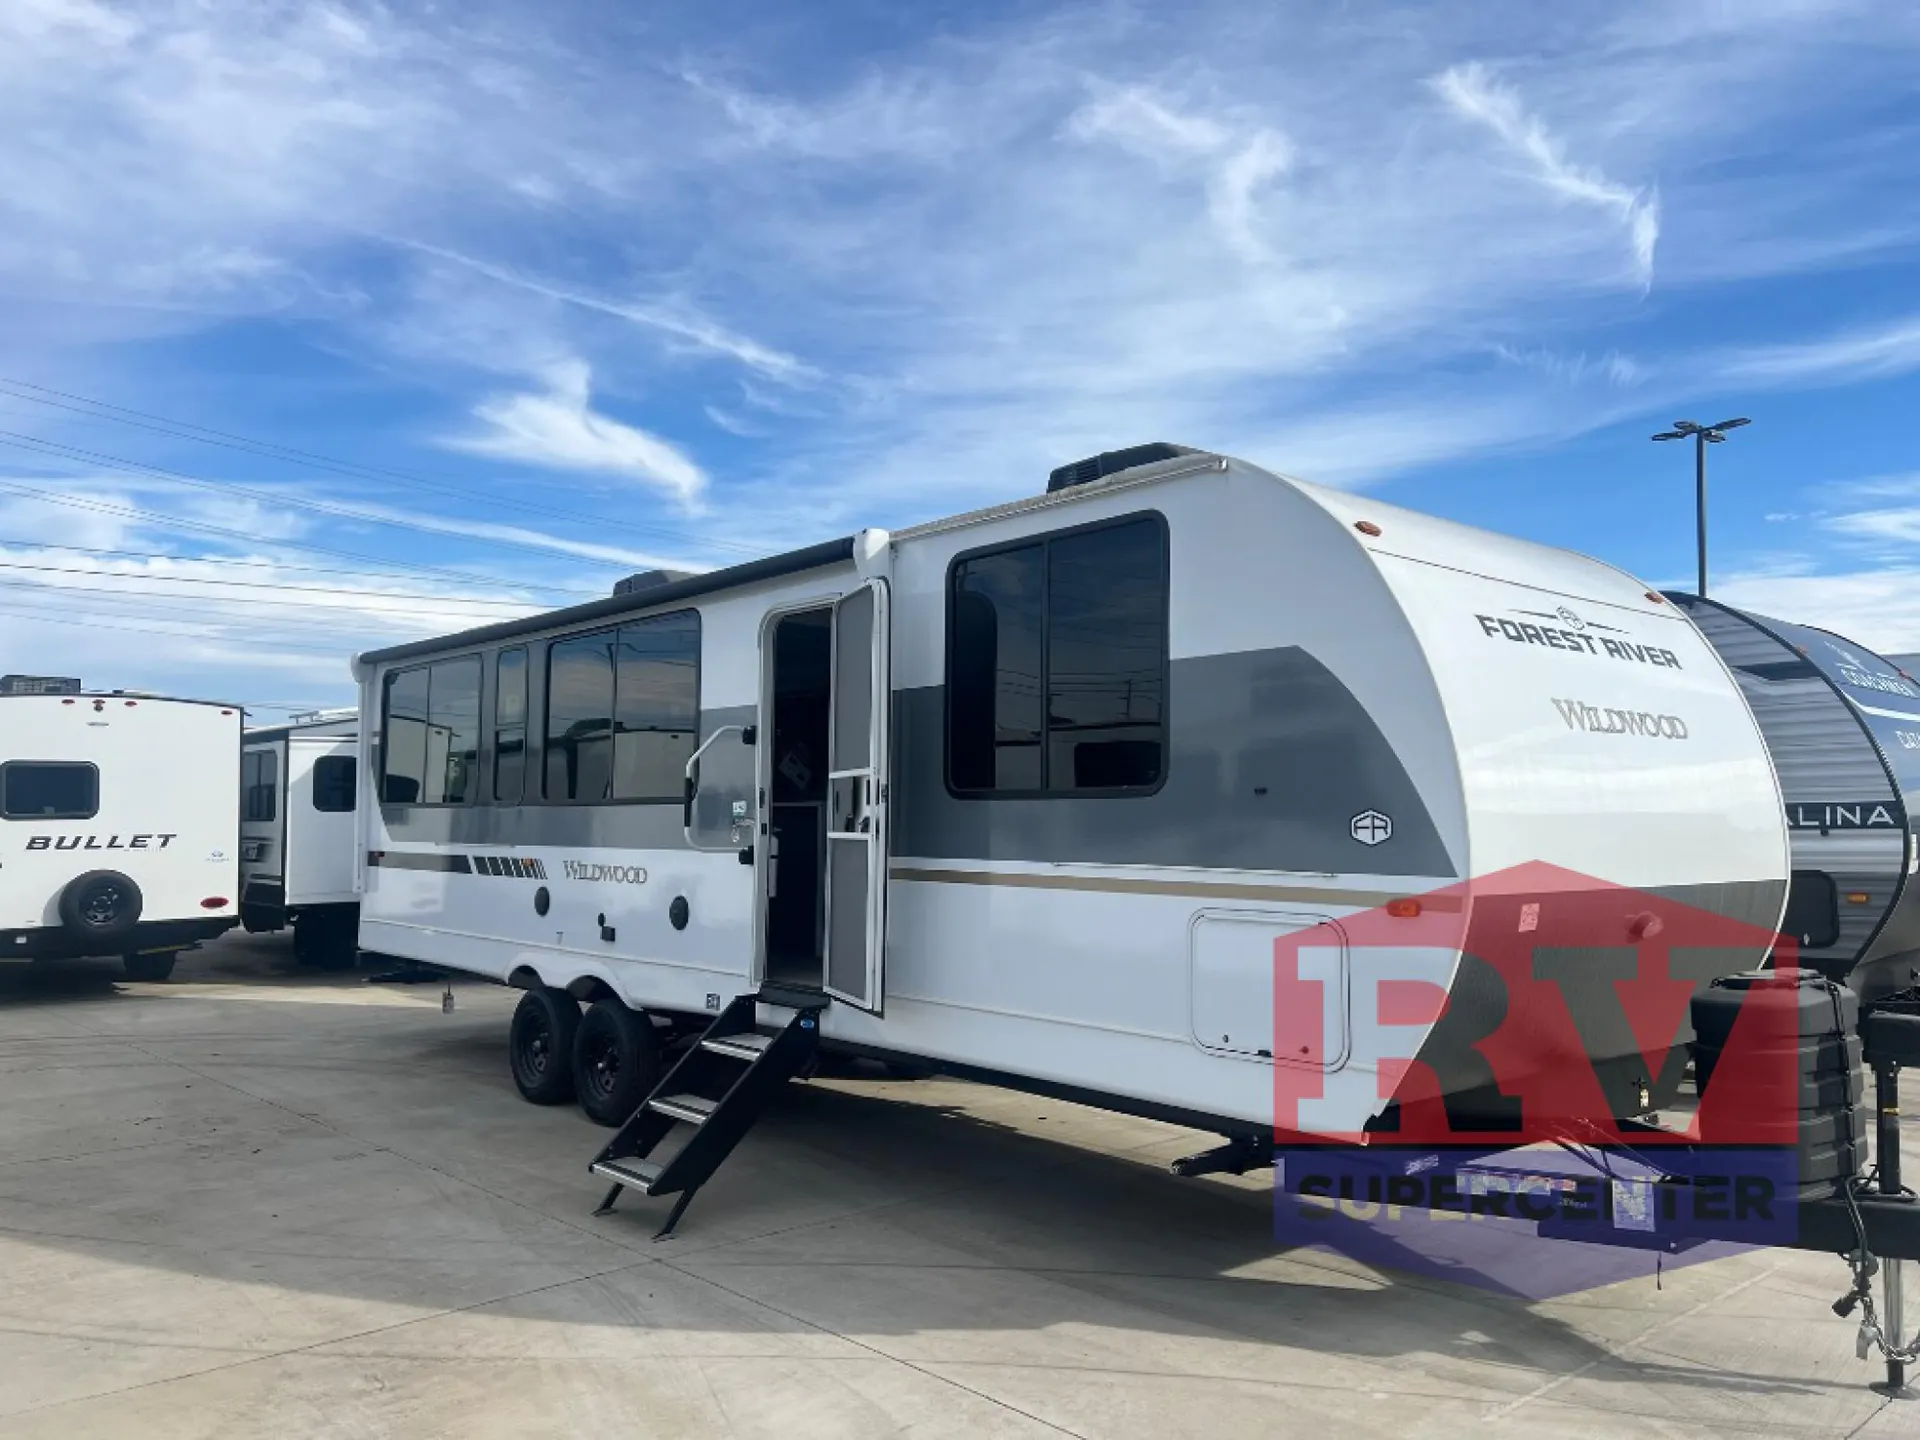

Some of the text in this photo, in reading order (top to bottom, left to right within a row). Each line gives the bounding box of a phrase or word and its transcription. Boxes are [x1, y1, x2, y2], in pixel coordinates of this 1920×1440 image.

[1474, 613, 1684, 670] FOREST RIVER
[1551, 697, 1688, 740] WILDWOOD
[26, 834, 177, 850] BULLET
[563, 860, 648, 884] WILDWOOD
